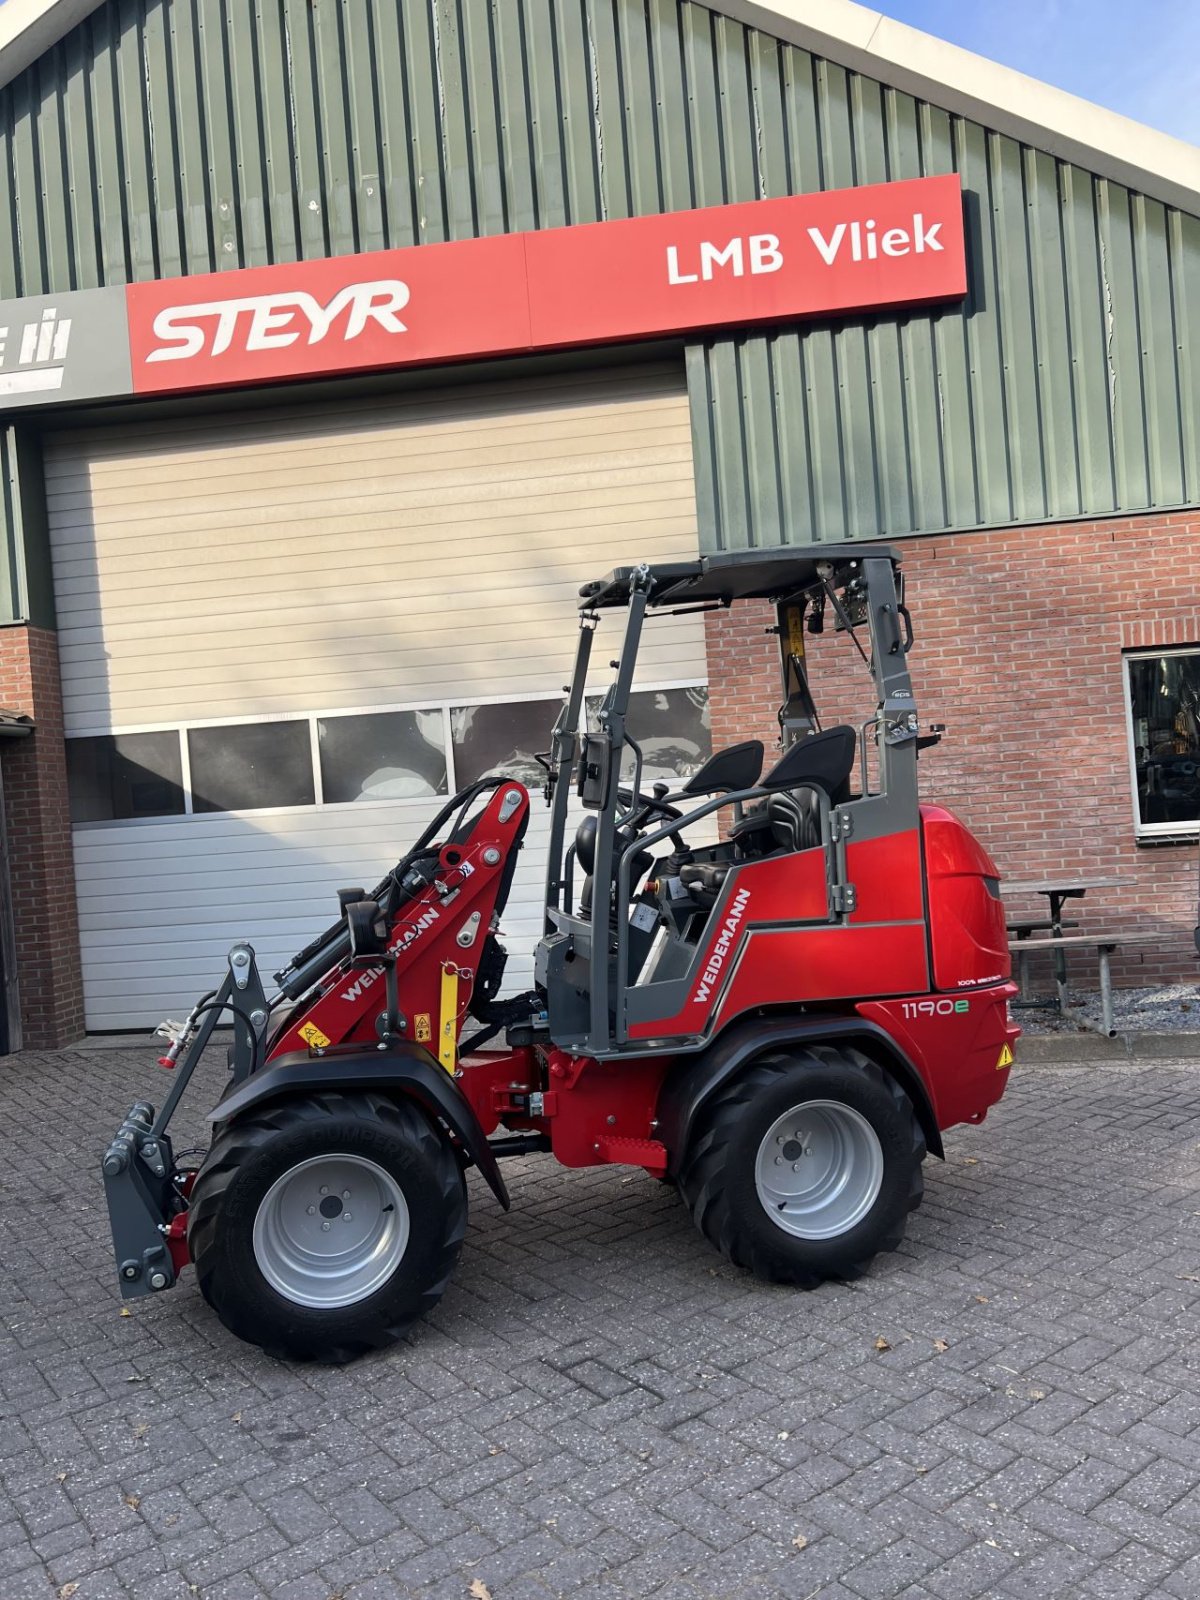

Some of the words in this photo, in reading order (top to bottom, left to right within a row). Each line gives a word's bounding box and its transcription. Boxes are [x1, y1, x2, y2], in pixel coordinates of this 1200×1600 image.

[666, 233, 784, 285] LMB
[807, 213, 944, 266] Vliek
[145, 279, 410, 363] STEYR
[340, 907, 440, 1002] WEIMANN
[693, 888, 751, 1003] WEIDEMANN
